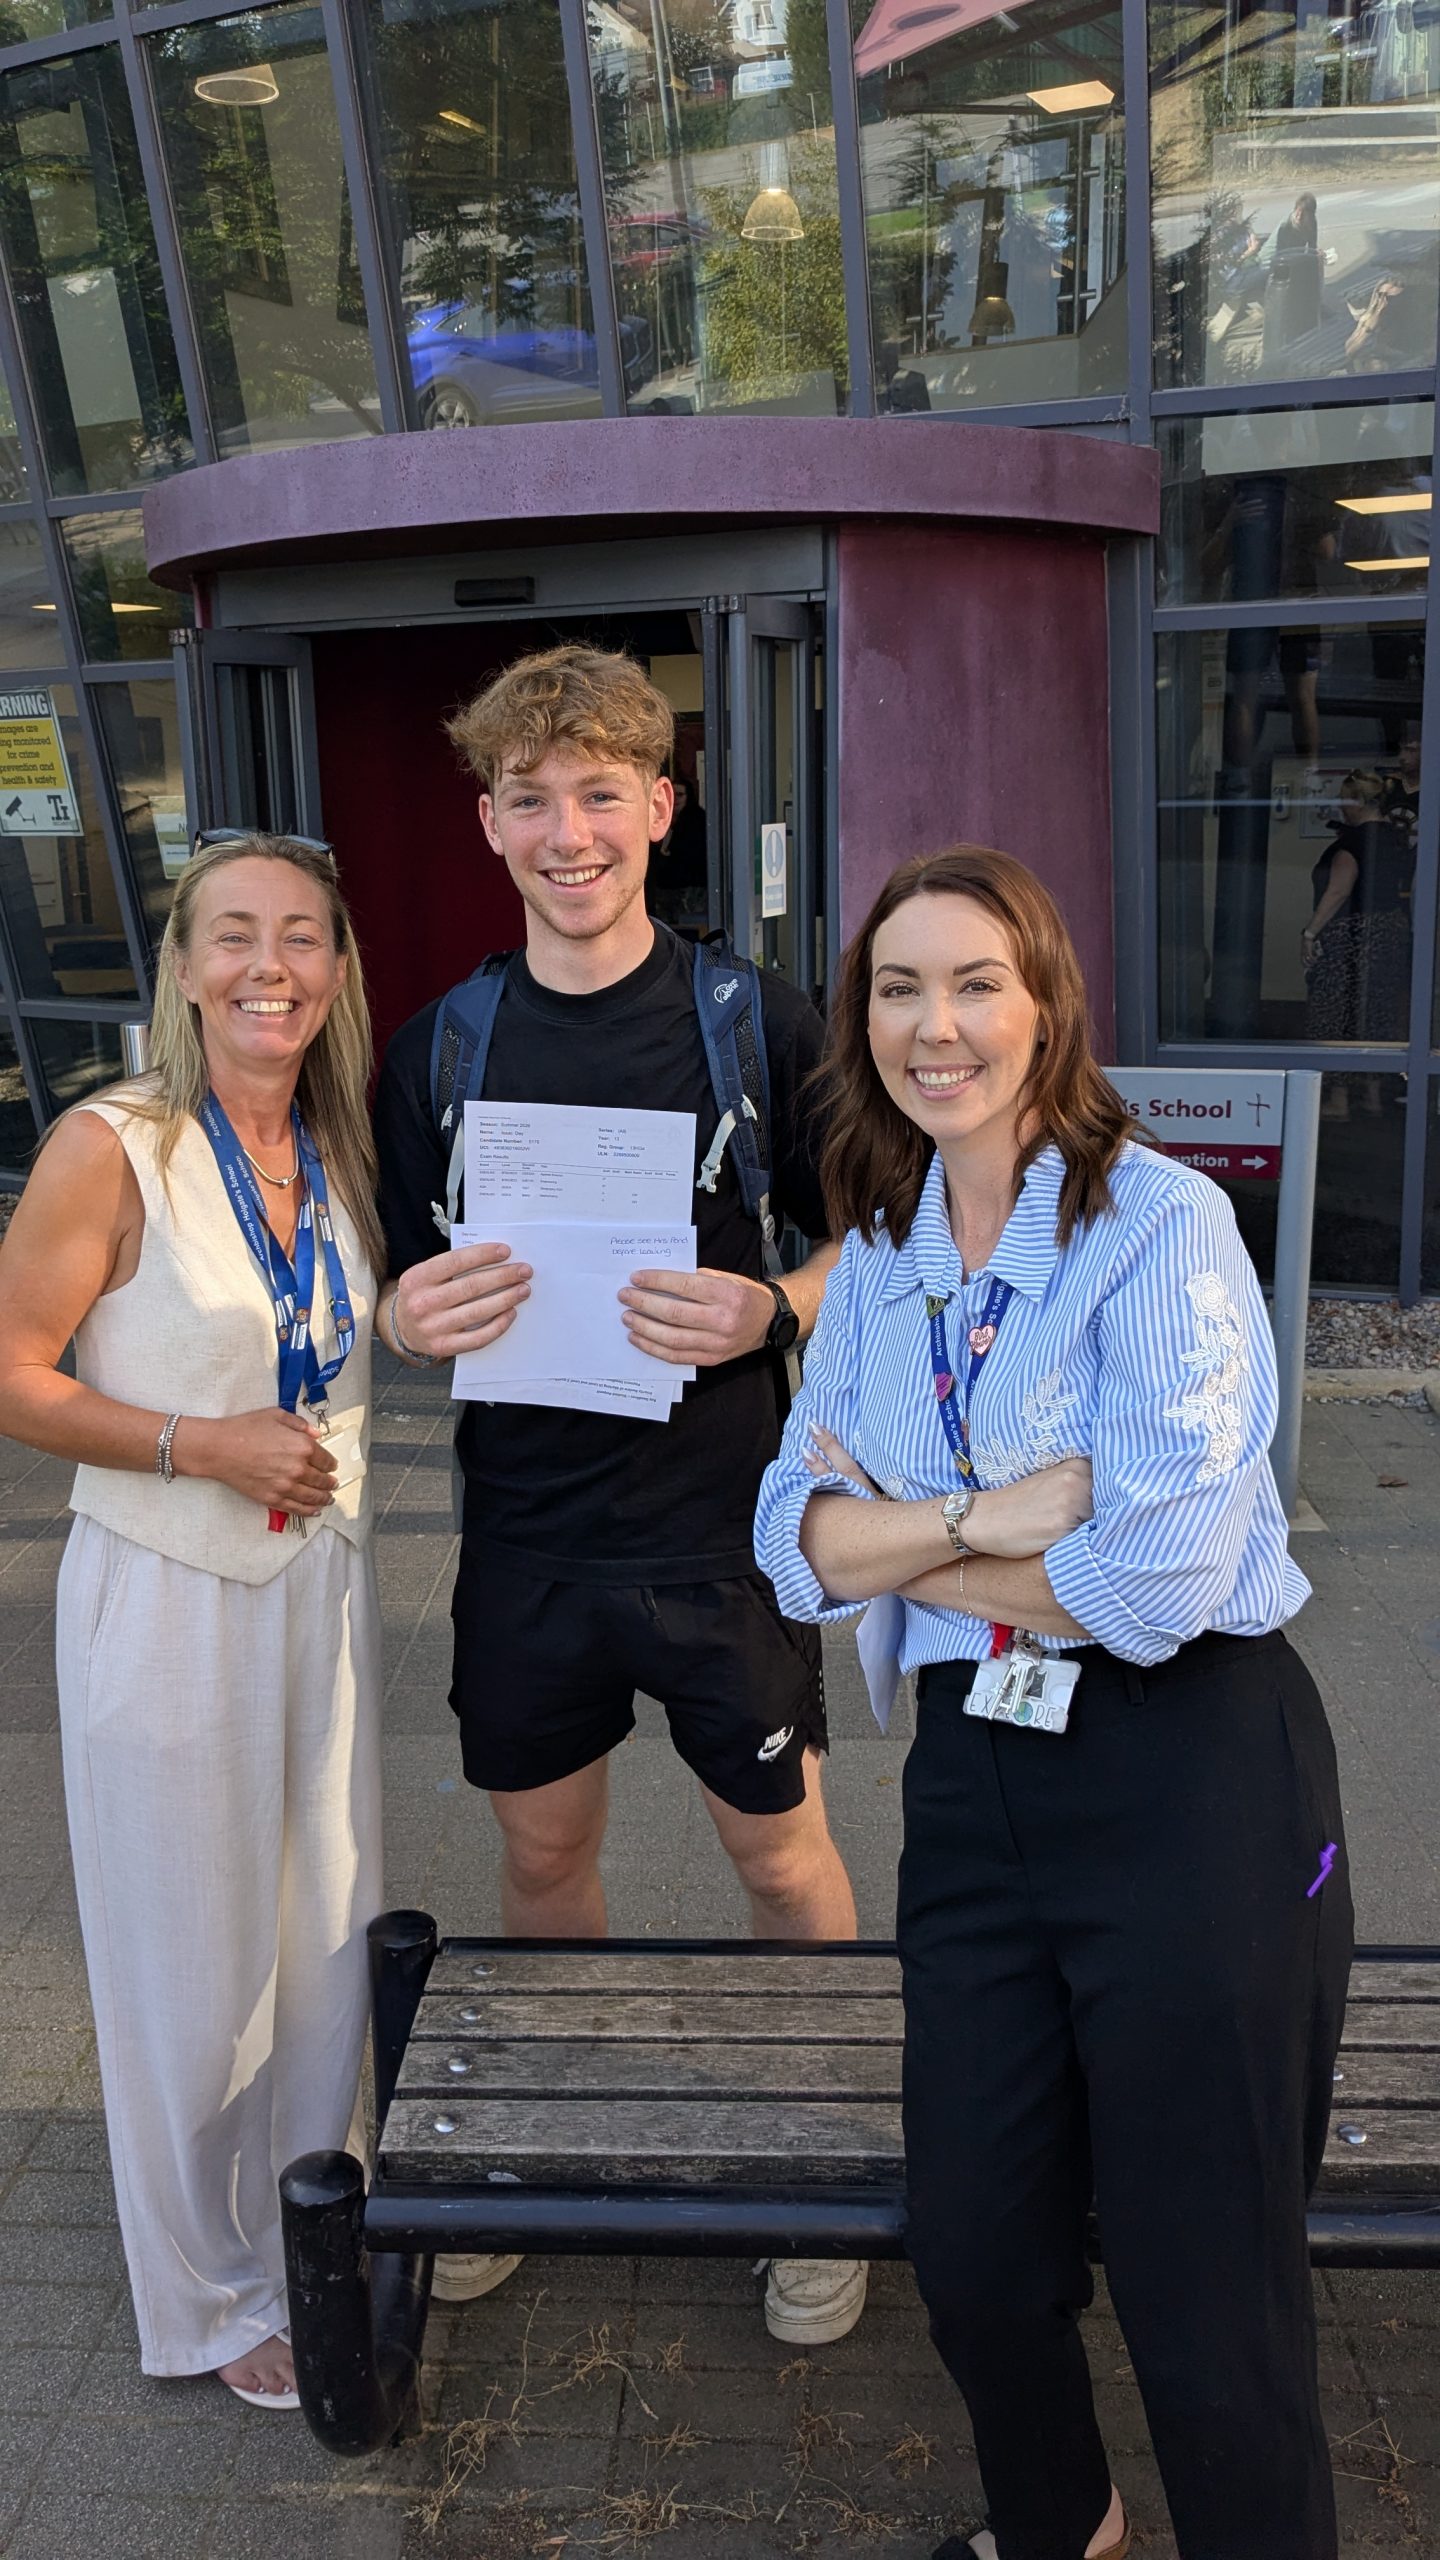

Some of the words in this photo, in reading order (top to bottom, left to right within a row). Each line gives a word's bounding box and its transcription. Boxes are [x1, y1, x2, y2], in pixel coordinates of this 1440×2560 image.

[0, 694, 50, 716] RNING
[13, 736, 51, 745] monitored
[40, 762, 55, 771] and
[2, 776, 26, 784] health
[35, 776, 57, 786] safety
[1149, 1098, 1232, 1119] School
[225, 1164, 239, 1189] School
[235, 1155, 250, 1179] School
[235, 1189, 251, 1221] Holgate's
[247, 1222, 265, 1261] Archbishop
[934, 1315, 943, 1356] Archbisho
[945, 1399, 955, 1421] Scho
[763, 1726, 787, 1750] NIKE
